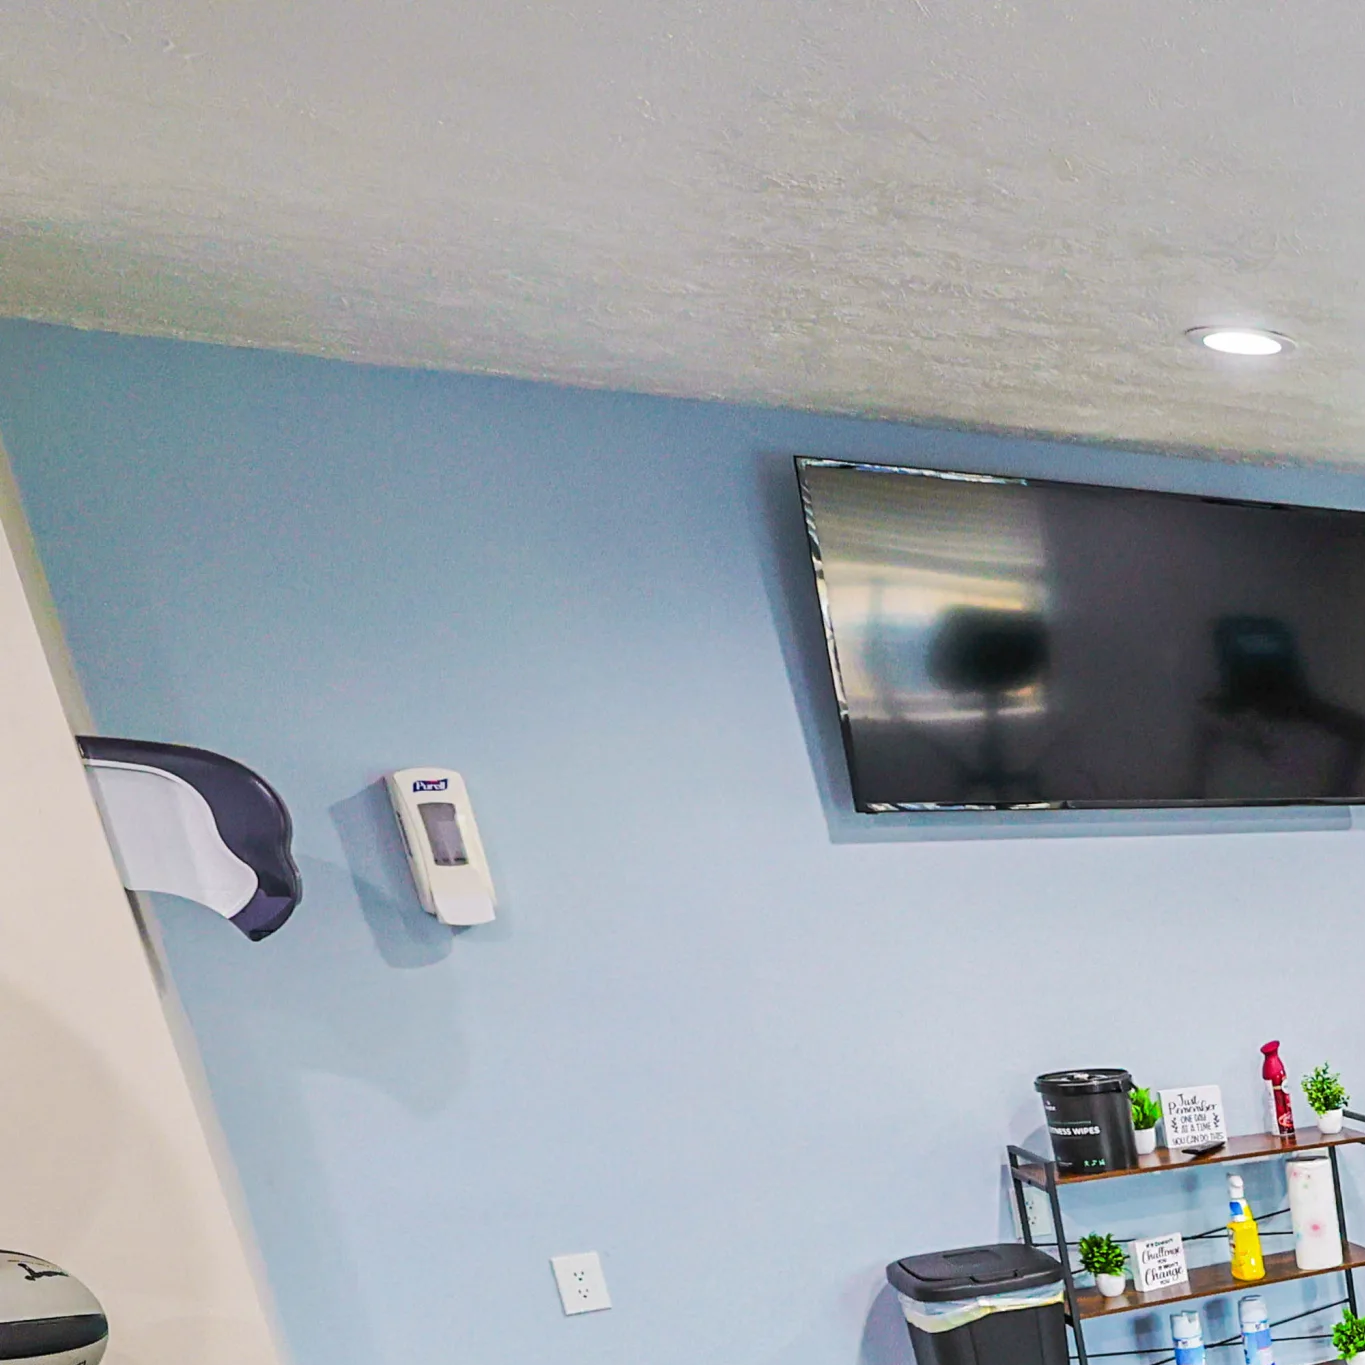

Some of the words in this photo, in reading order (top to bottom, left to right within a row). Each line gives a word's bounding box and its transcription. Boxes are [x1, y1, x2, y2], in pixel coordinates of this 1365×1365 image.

[1177, 1093, 1198, 1106] Just
[1180, 1115, 1192, 1124] ONE
[1072, 1126, 1100, 1135] WIPES
[1196, 1122, 1211, 1131] TIME
[1172, 1137, 1185, 1145] YOU
[1187, 1134, 1199, 1144] CAN
[1200, 1134, 1208, 1142] DO
[1145, 1266, 1183, 1285] Change
